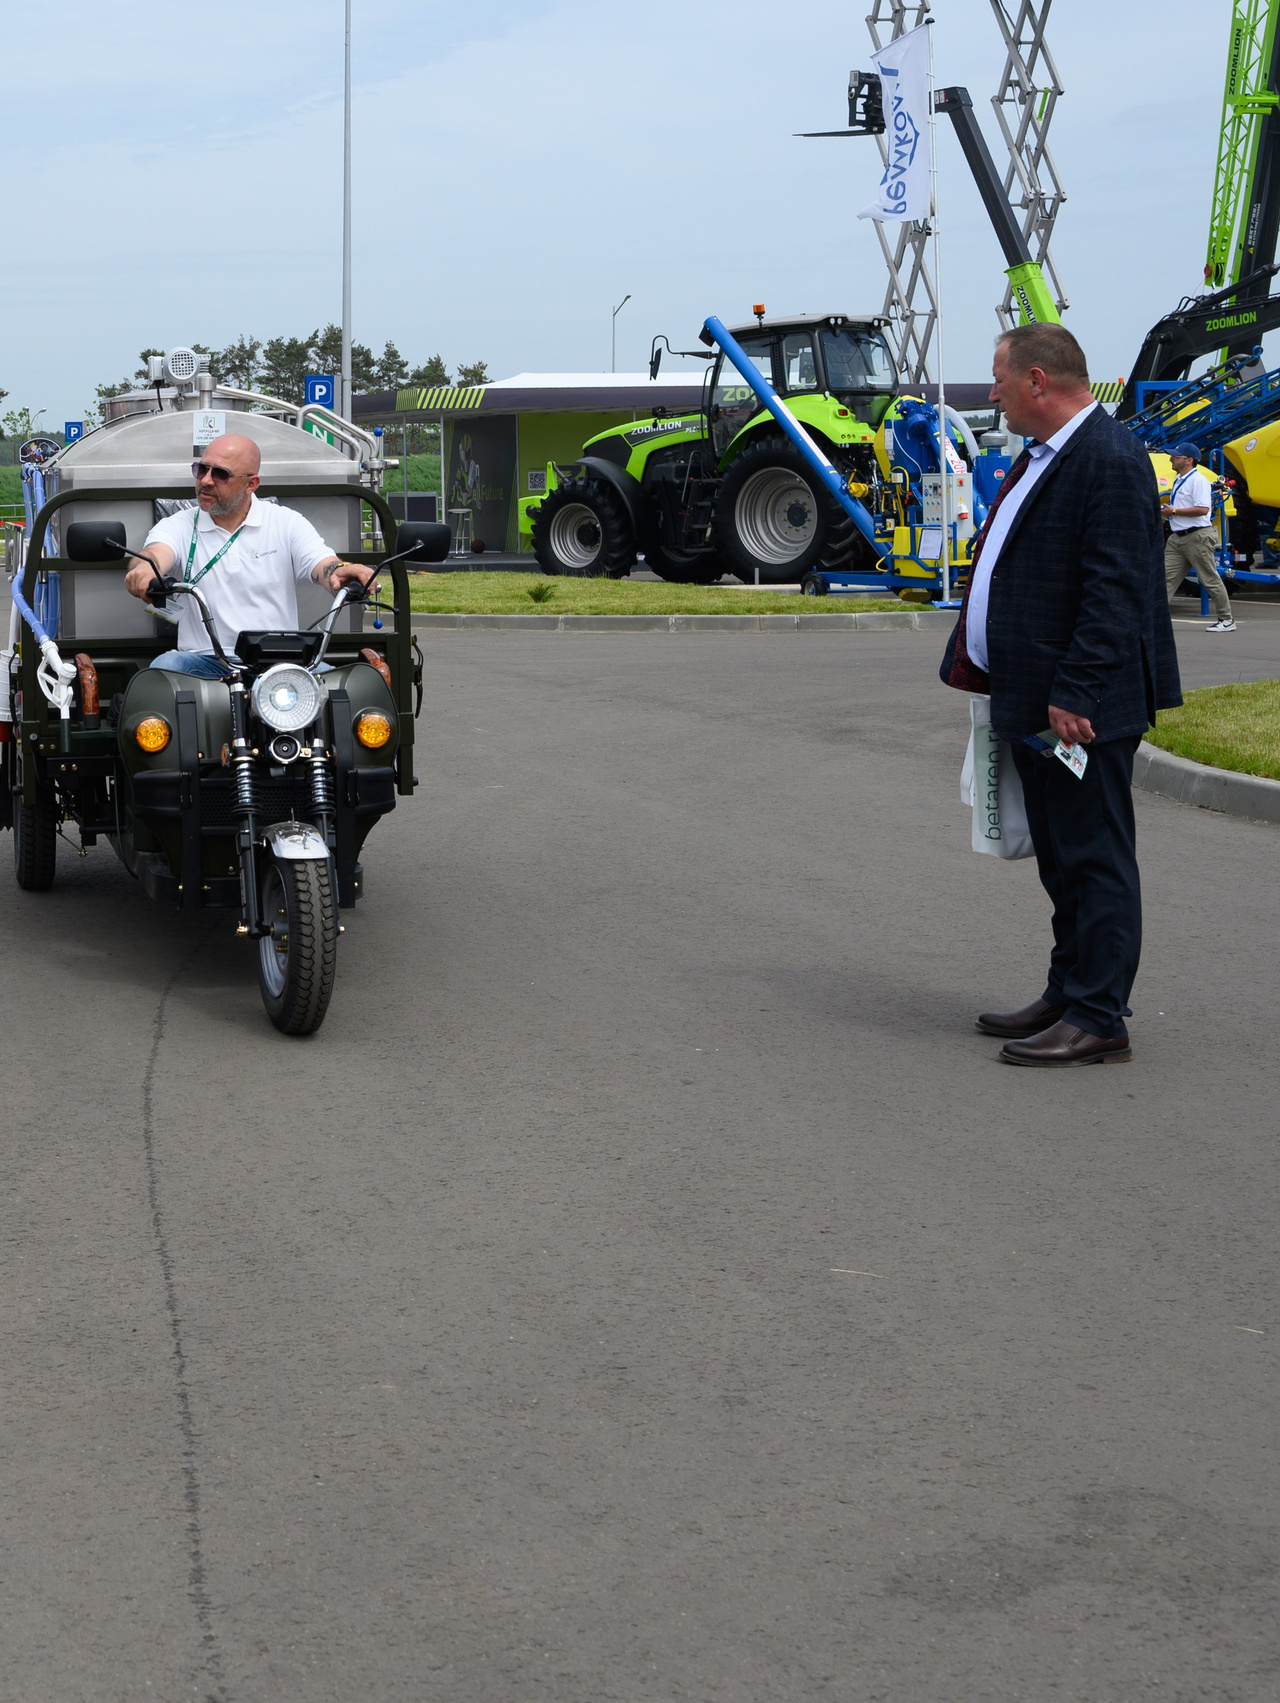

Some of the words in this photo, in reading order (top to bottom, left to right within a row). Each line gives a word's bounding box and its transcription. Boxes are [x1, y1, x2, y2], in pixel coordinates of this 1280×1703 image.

[1228, 27, 1242, 96] ZOOMLION
[1016, 285, 1037, 324] ZOOMLI
[1205, 311, 1257, 332] ZOOMLION
[315, 384, 327, 400] P
[70, 427, 79, 437] P
